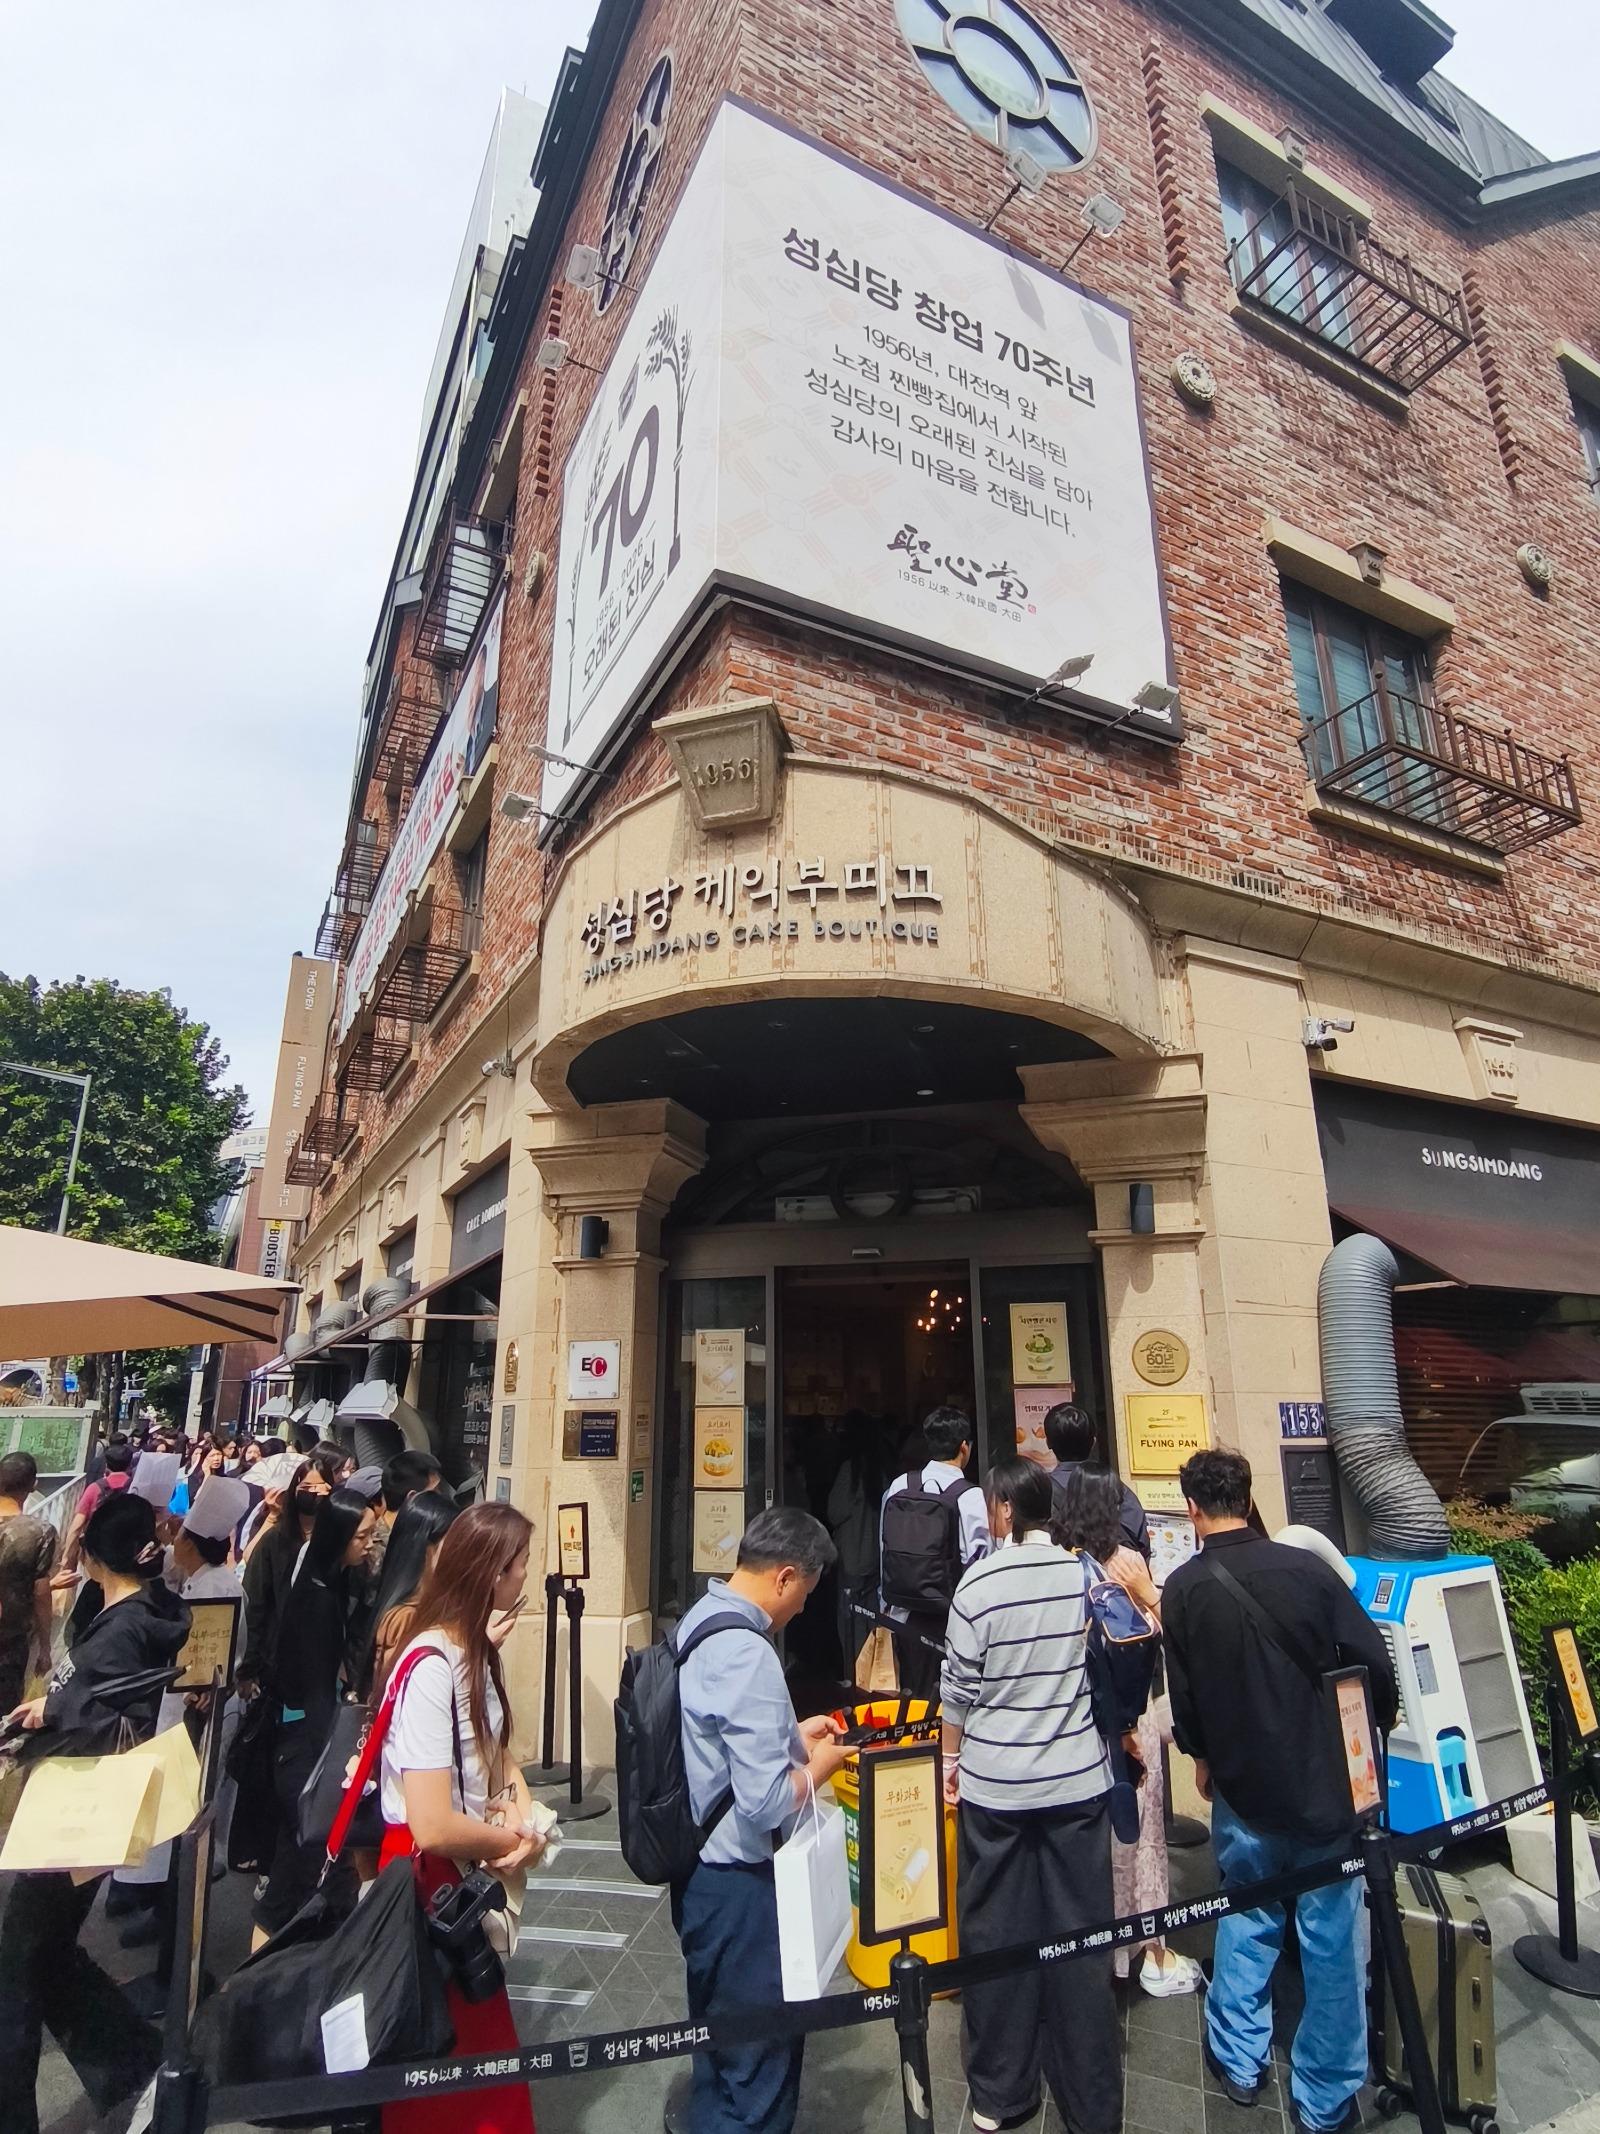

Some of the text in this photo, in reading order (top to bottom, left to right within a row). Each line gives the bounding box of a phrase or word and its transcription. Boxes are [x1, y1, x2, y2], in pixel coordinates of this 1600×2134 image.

[783, 227, 1096, 408] 성심당 창업 70주년
[863, 324, 1038, 424] 1956년, 대전역 앞
[832, 344, 1067, 467] 노점 찐빵집에서 시작된
[804, 368, 1093, 511] 성심당의 오래된 진심을 담아
[591, 404, 660, 600] 70
[830, 415, 1077, 538] 감사의 마음을 전합니다.
[583, 538, 656, 692] 오래된 진심
[898, 569, 925, 587] 1956
[1001, 608, 1022, 623] 大田
[581, 875, 684, 956] 성심당
[582, 919, 940, 985] SUNGSIMDANG CAKE BOUTIQUE
[304, 970, 318, 1011] THE OVEN
[292, 1056, 307, 1108] FLYING PAN
[1422, 1147, 1543, 1181] SUNGSIMDANG
[264, 1229, 280, 1278] BOOSTER
[1140, 1440, 1199, 1448] FLYING PAN
[1289, 1407, 1319, 1431] 153
[1118, 1924, 1133, 1939] 大田
[1163, 1907, 1188, 1929] 성심당
[529, 2053, 552, 2070] 大田
[603, 2035, 643, 2060] 성심당
